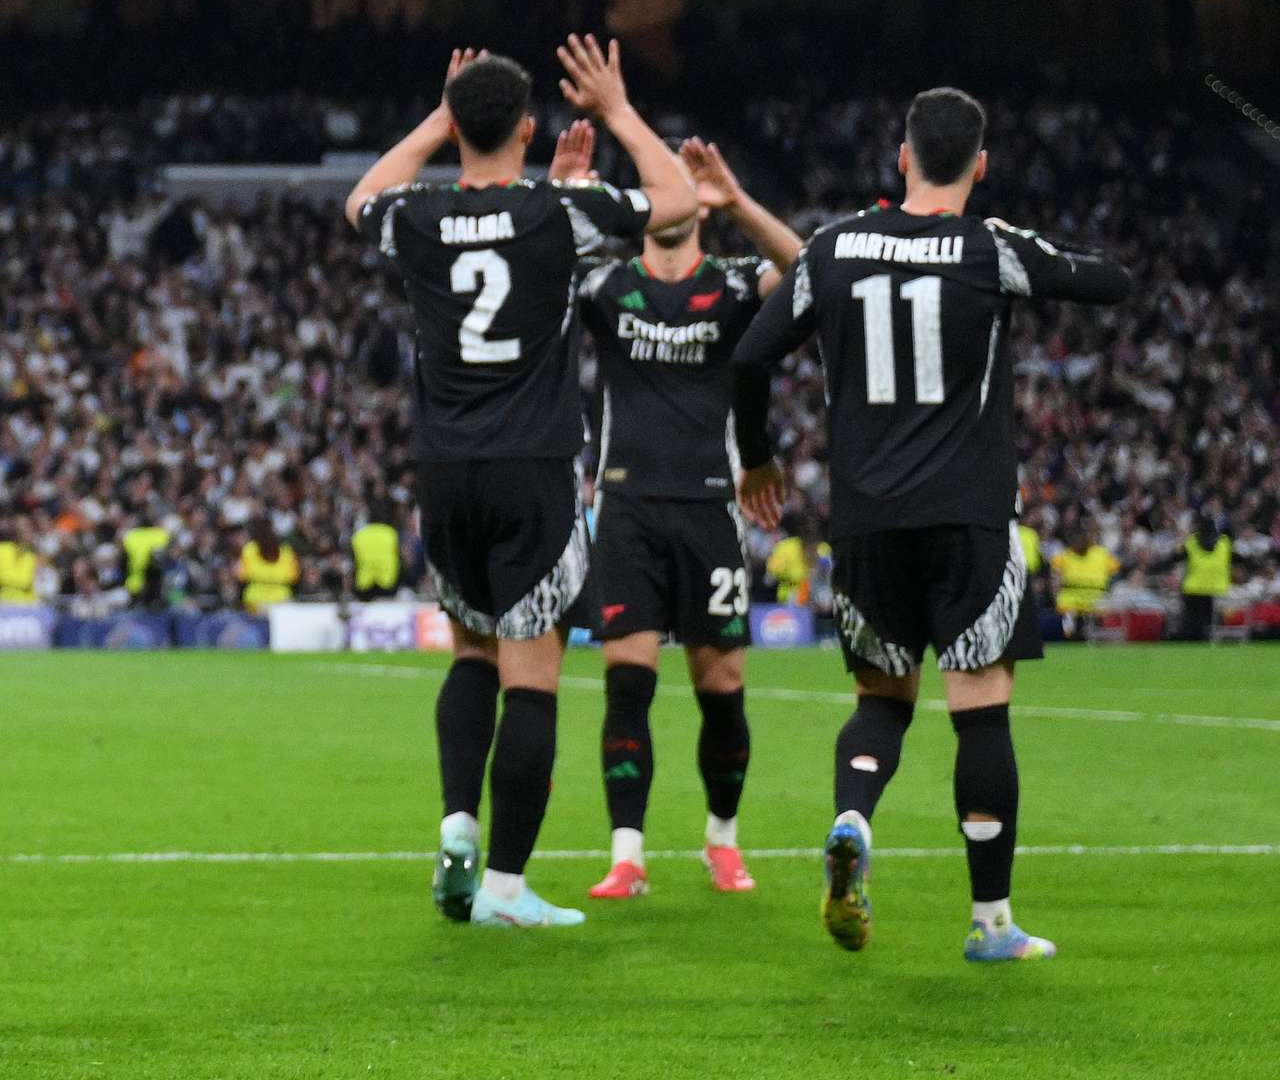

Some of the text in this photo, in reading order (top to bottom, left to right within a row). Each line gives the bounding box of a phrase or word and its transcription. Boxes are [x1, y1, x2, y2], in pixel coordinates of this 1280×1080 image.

[834, 232, 964, 263] MARTINELLI
[450, 249, 521, 363] 2
[851, 274, 945, 404] 11
[707, 567, 749, 615] 23
